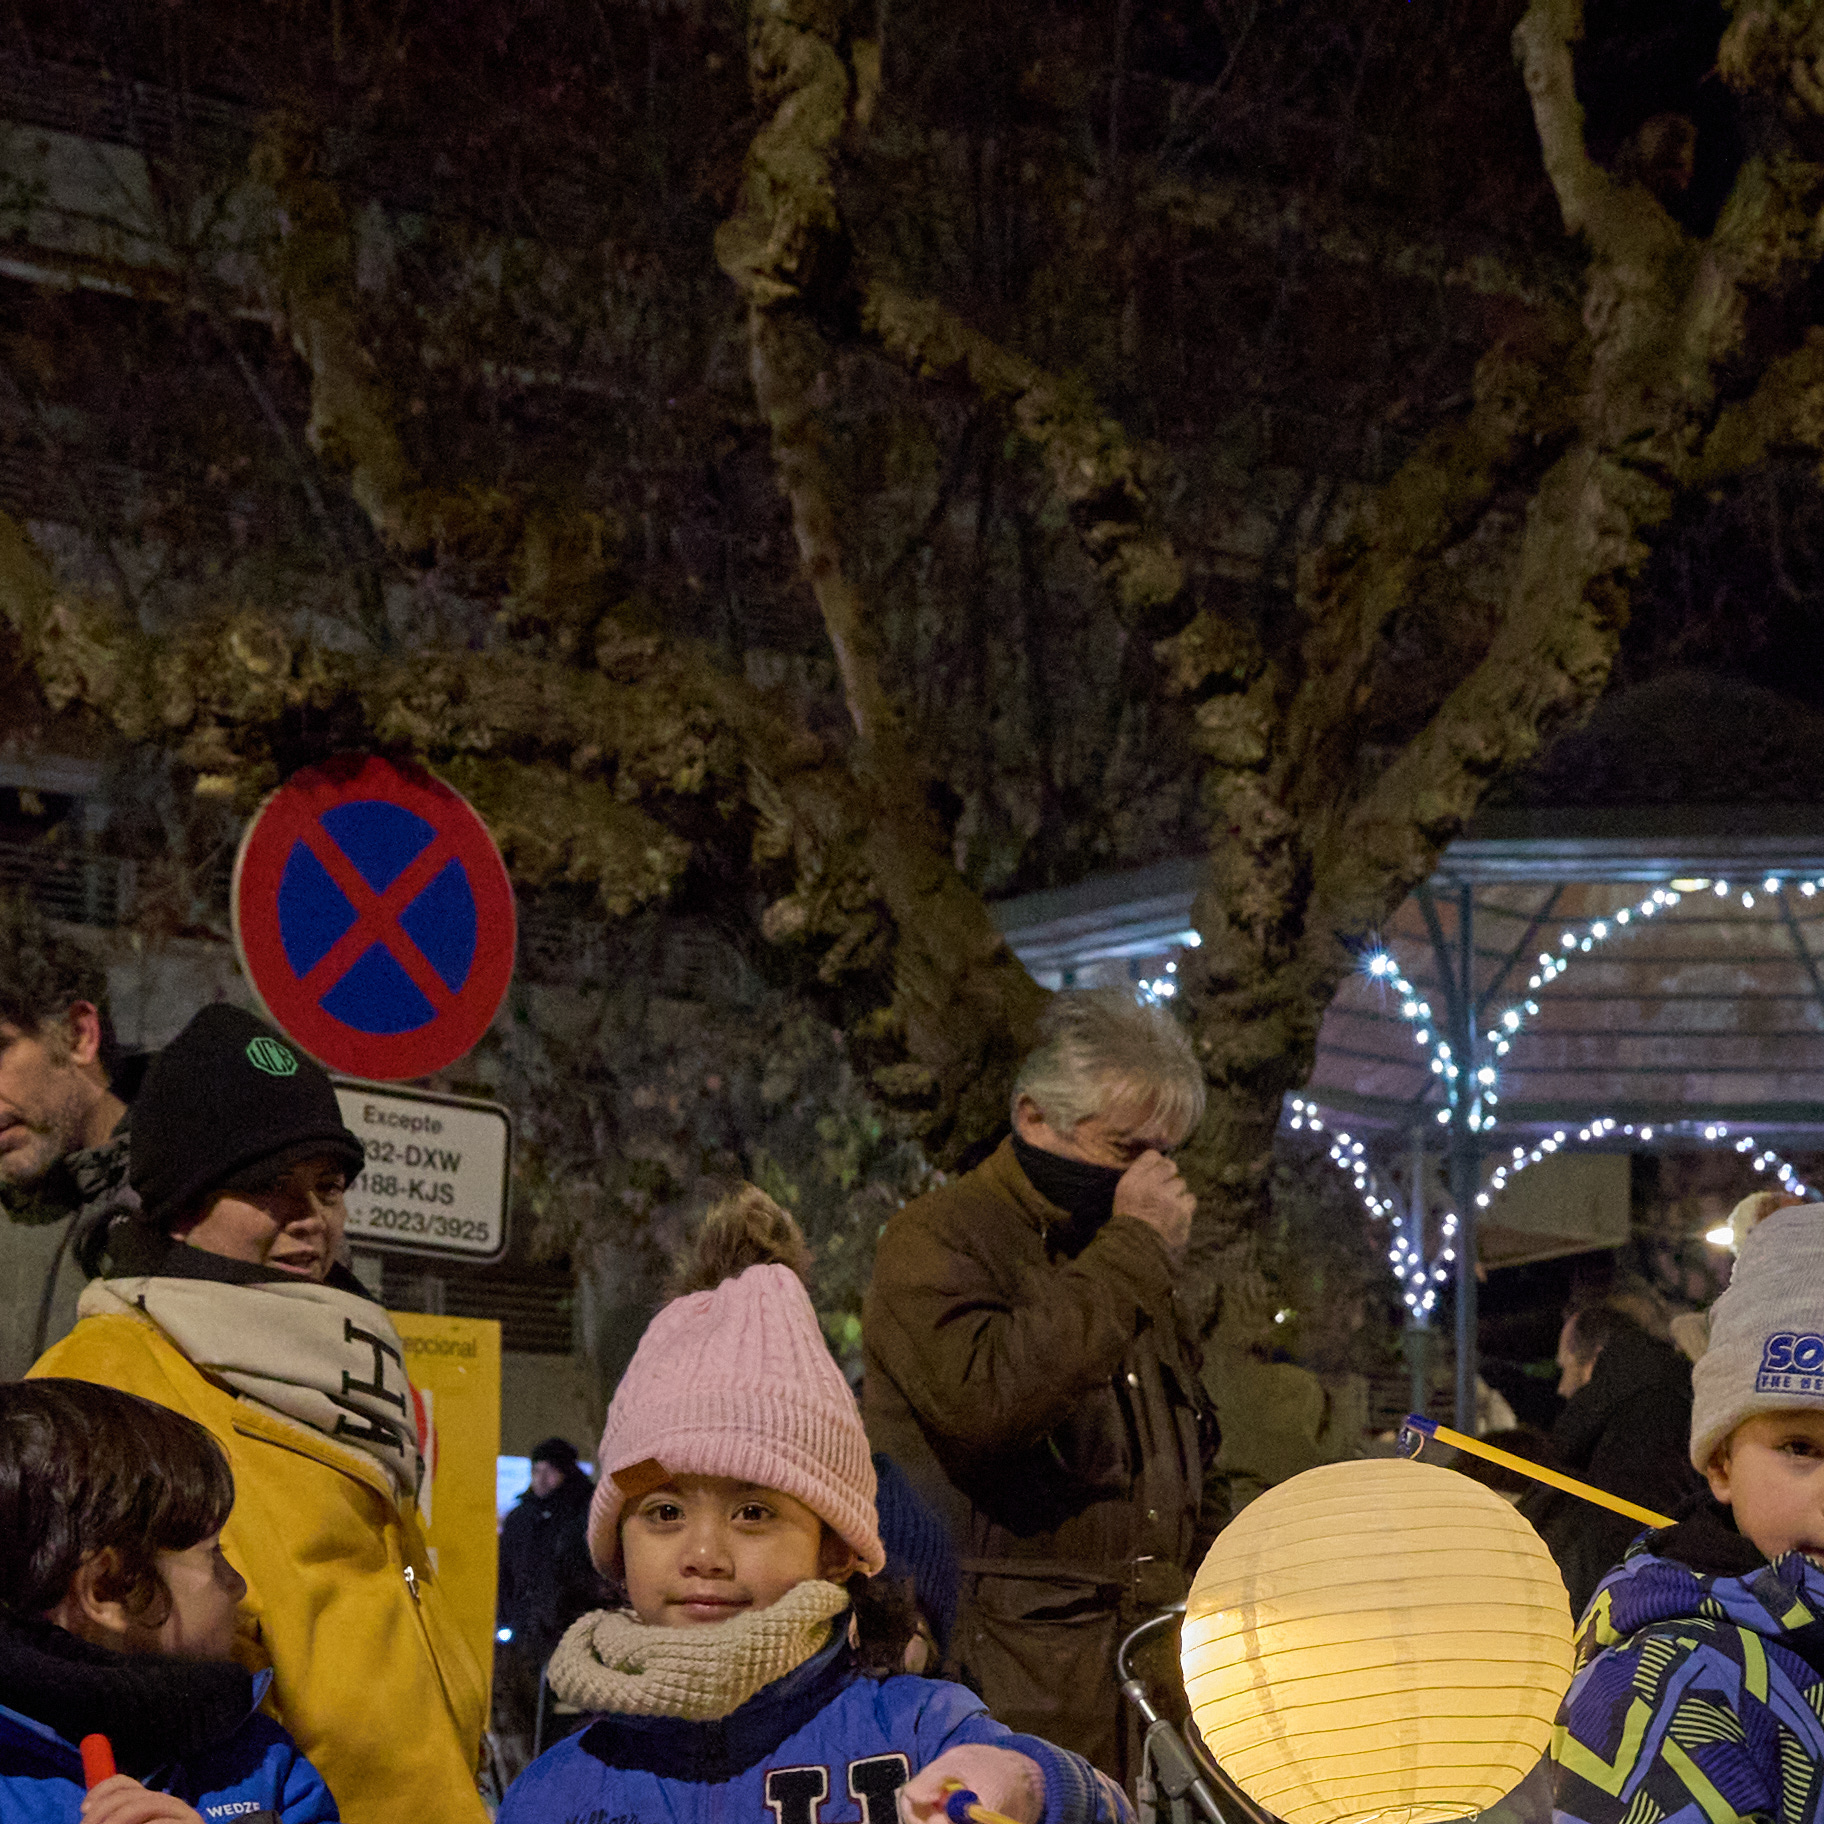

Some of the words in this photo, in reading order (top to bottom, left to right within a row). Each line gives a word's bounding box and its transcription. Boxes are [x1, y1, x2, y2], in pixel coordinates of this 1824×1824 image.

[363, 1104, 443, 1134] Excepte
[350, 1172, 455, 1206] 188-KJS
[369, 1207, 490, 1242] 2023/3925
[1761, 1374, 1792, 1388] THE
